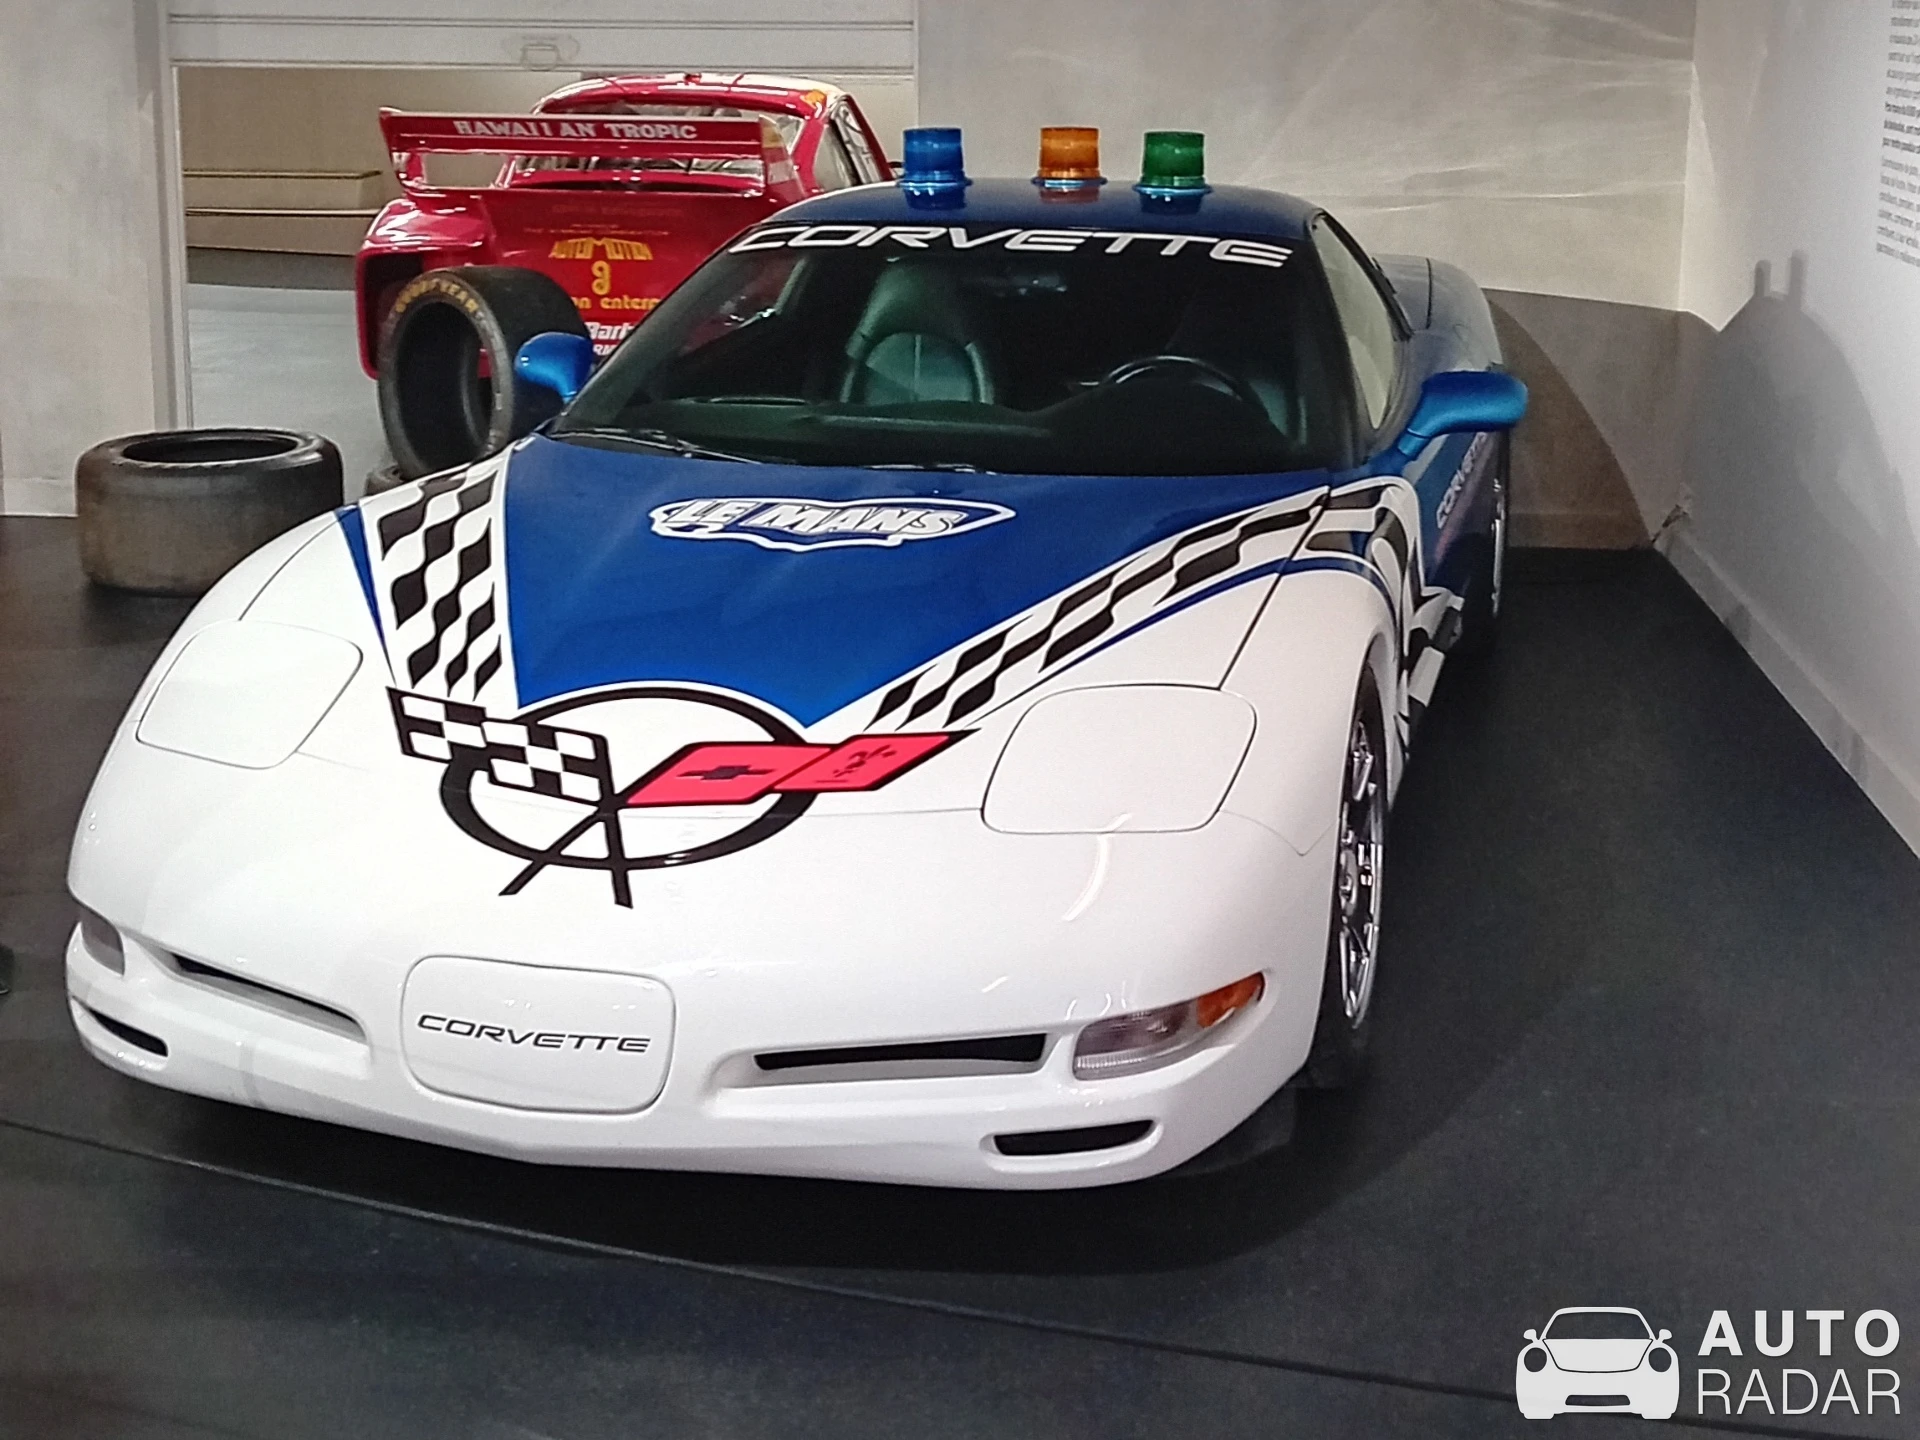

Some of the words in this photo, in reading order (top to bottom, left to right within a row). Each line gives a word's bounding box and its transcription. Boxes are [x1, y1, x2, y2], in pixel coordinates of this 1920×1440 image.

[604, 123, 698, 139] TROPIC
[728, 225, 1293, 268] CORVETTE
[665, 500, 760, 524] LE
[740, 504, 968, 535] MANS
[417, 1014, 651, 1053] CORVETTE
